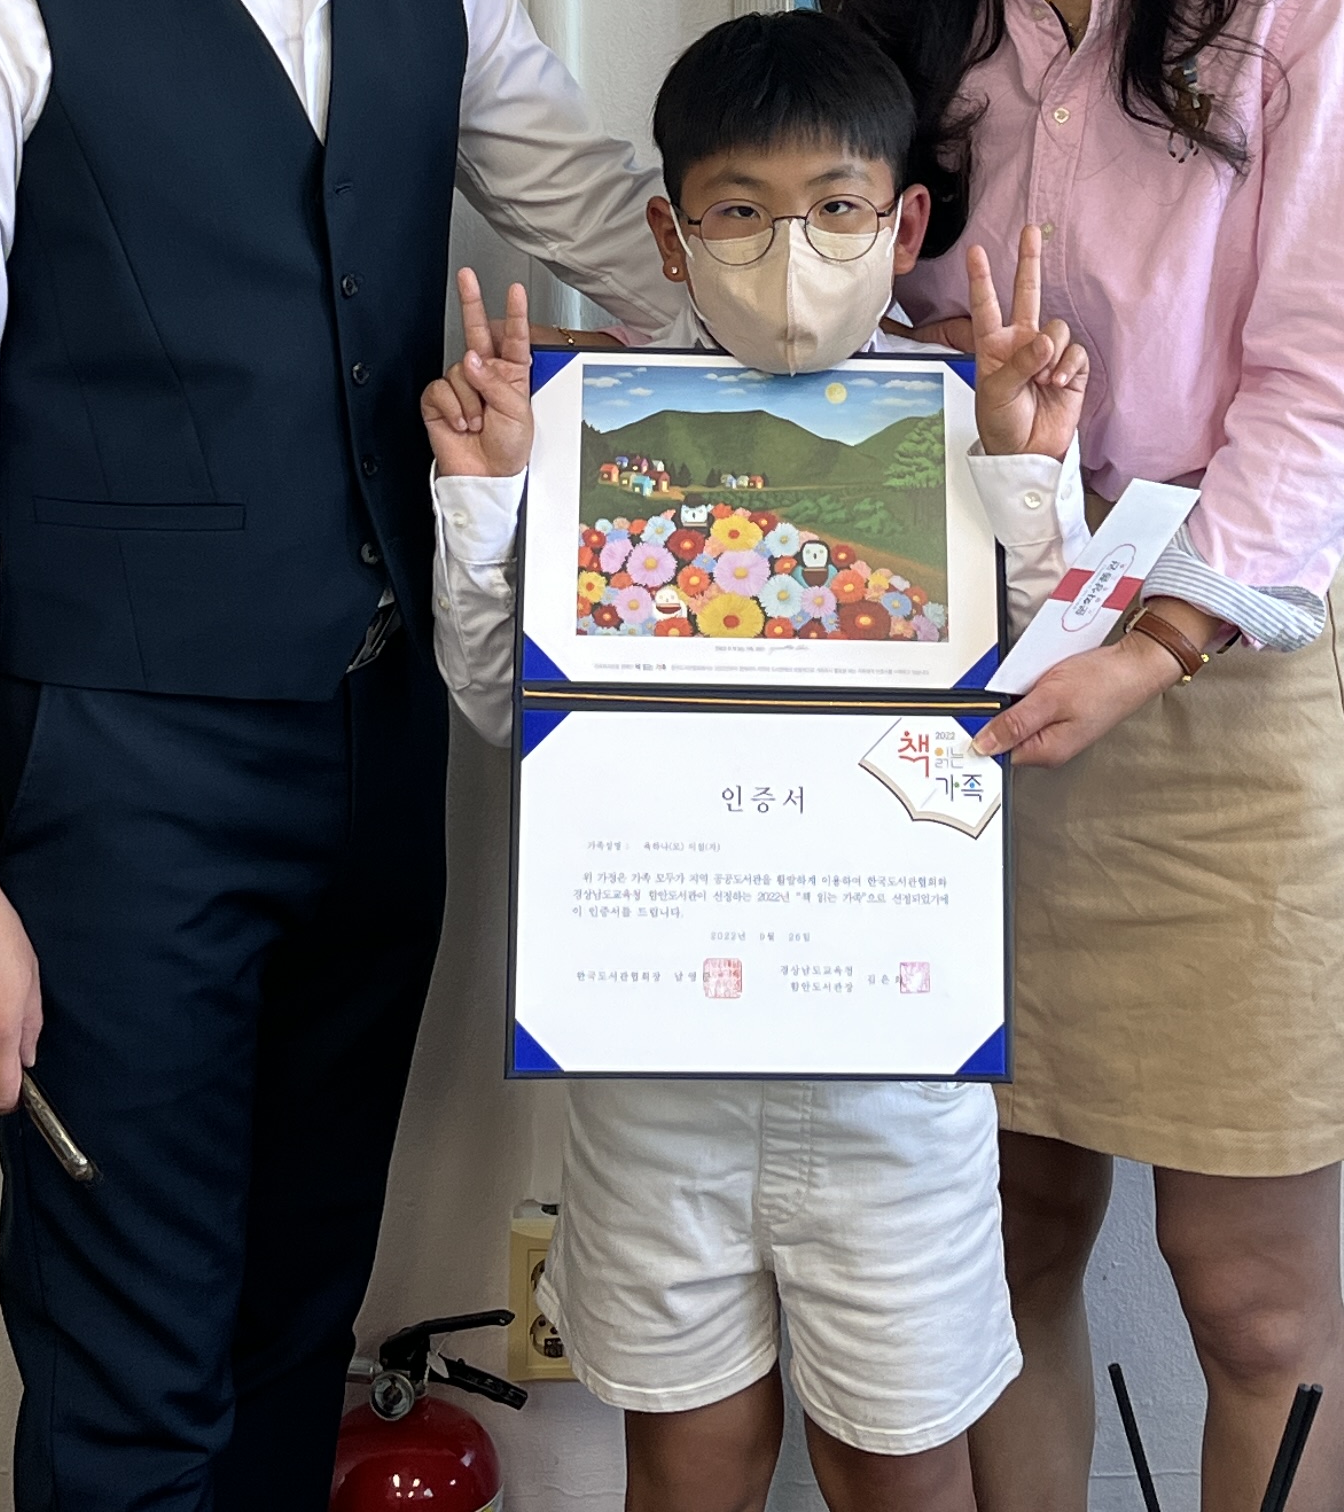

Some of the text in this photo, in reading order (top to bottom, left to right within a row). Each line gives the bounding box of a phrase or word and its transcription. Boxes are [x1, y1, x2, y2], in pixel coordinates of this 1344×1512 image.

[935, 731, 955, 740] 2022
[898, 730, 930, 778] 책
[722, 784, 803, 814] 인증서
[935, 774, 984, 802] 가족
